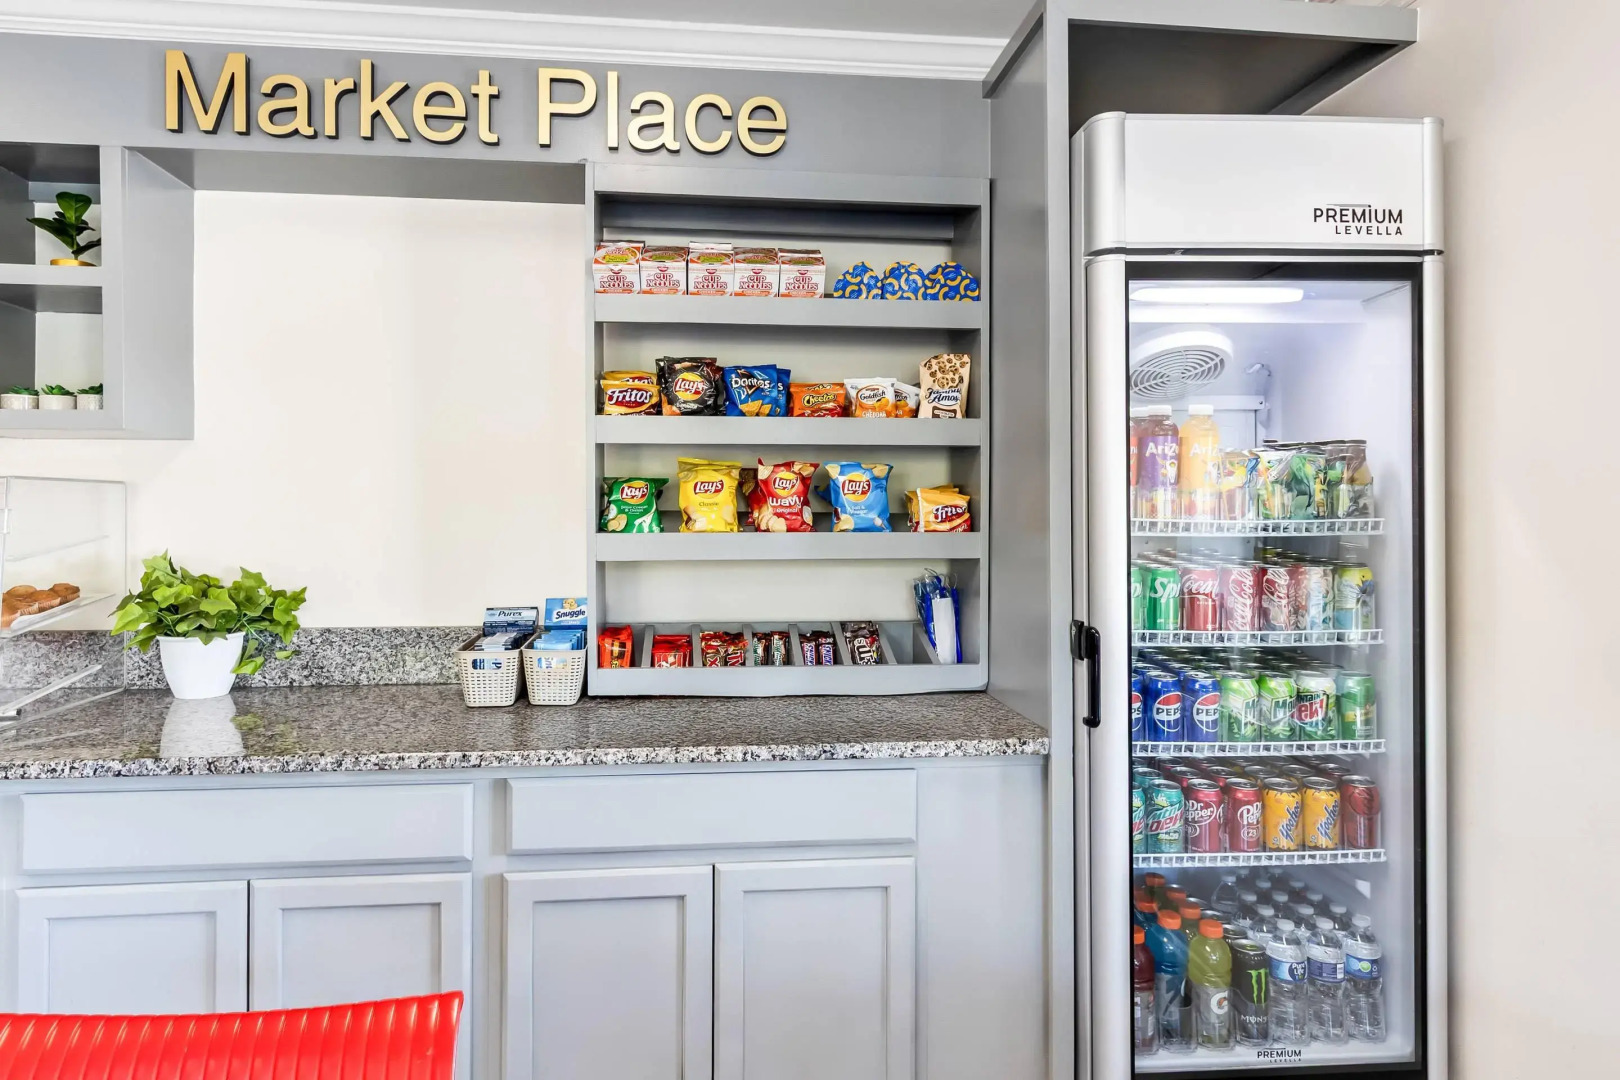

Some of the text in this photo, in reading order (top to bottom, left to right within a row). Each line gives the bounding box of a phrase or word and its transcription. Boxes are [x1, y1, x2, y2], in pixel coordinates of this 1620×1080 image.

[165, 50, 788, 156] Market Place
[1314, 206, 1402, 224] PREMIUM
[1335, 225, 1402, 236] LEVELLA
[607, 275, 627, 283] CUP
[654, 273, 673, 281] CUP
[701, 275, 721, 284] CUP
[747, 275, 766, 284] CUP
[793, 276, 812, 284] CUP
[646, 279, 680, 287] NOODLES
[694, 281, 727, 290] NOODLES
[739, 281, 772, 290] NOODLES
[785, 282, 818, 290] NOODLES
[675, 378, 707, 396] Lay's
[732, 375, 771, 389] Doritos
[607, 388, 652, 405] Fritos
[803, 394, 837, 406] Cheetos
[860, 390, 886, 401] Goldfish
[928, 394, 961, 404] Amos
[695, 481, 722, 496] Lay's
[774, 477, 798, 491] Lay's
[844, 480, 869, 496] Lay's
[622, 485, 648, 500] Lay's
[556, 609, 586, 619] Snuggle
[1257, 1049, 1302, 1058] PREMIUM
